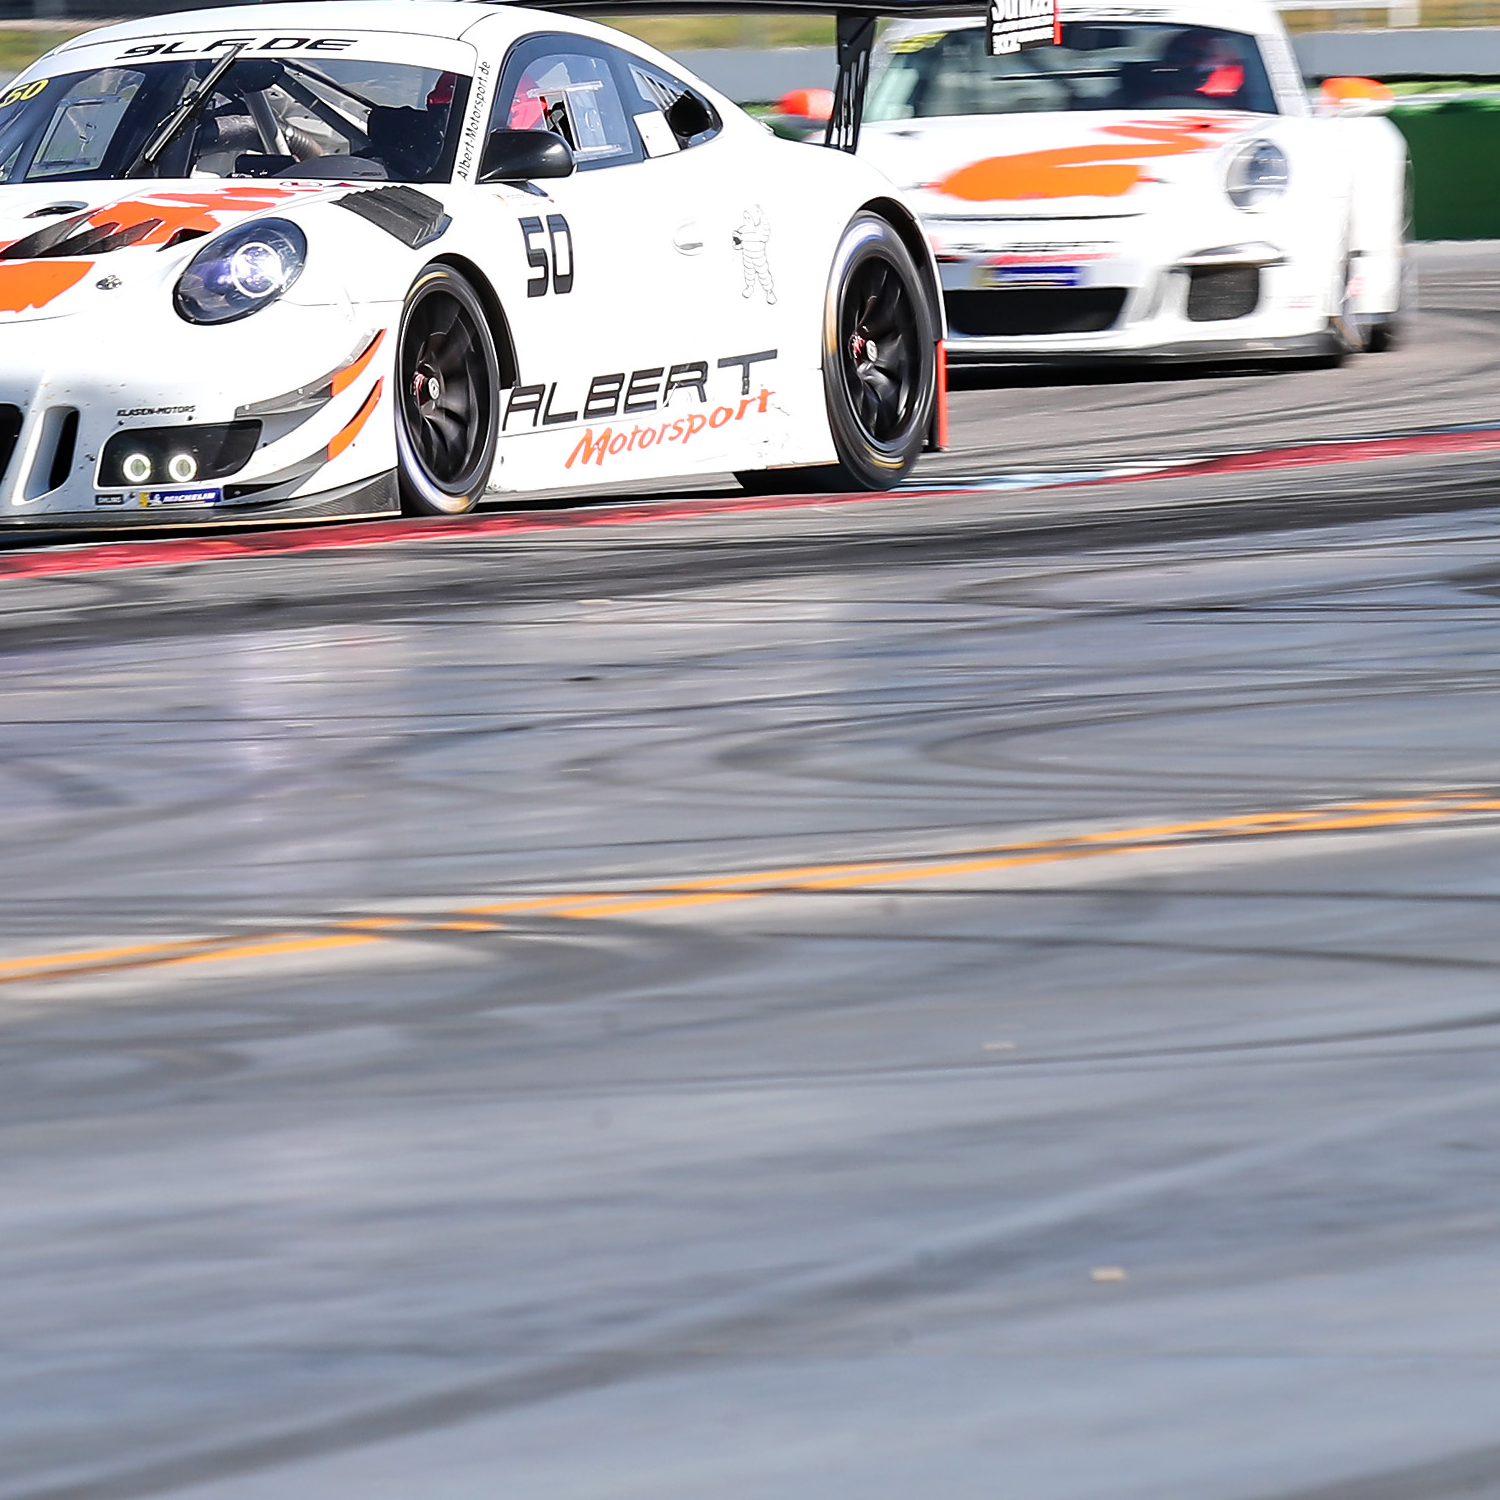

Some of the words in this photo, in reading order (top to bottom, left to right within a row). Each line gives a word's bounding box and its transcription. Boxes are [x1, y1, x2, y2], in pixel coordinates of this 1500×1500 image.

[0, 78, 50, 107] 50
[457, 60, 491, 181] Albert-Motorsport.de
[517, 213, 574, 298] 50
[501, 348, 779, 432] ALBERT
[564, 388, 777, 470] Motorsport
[162, 491, 217, 504] MICHELIN
